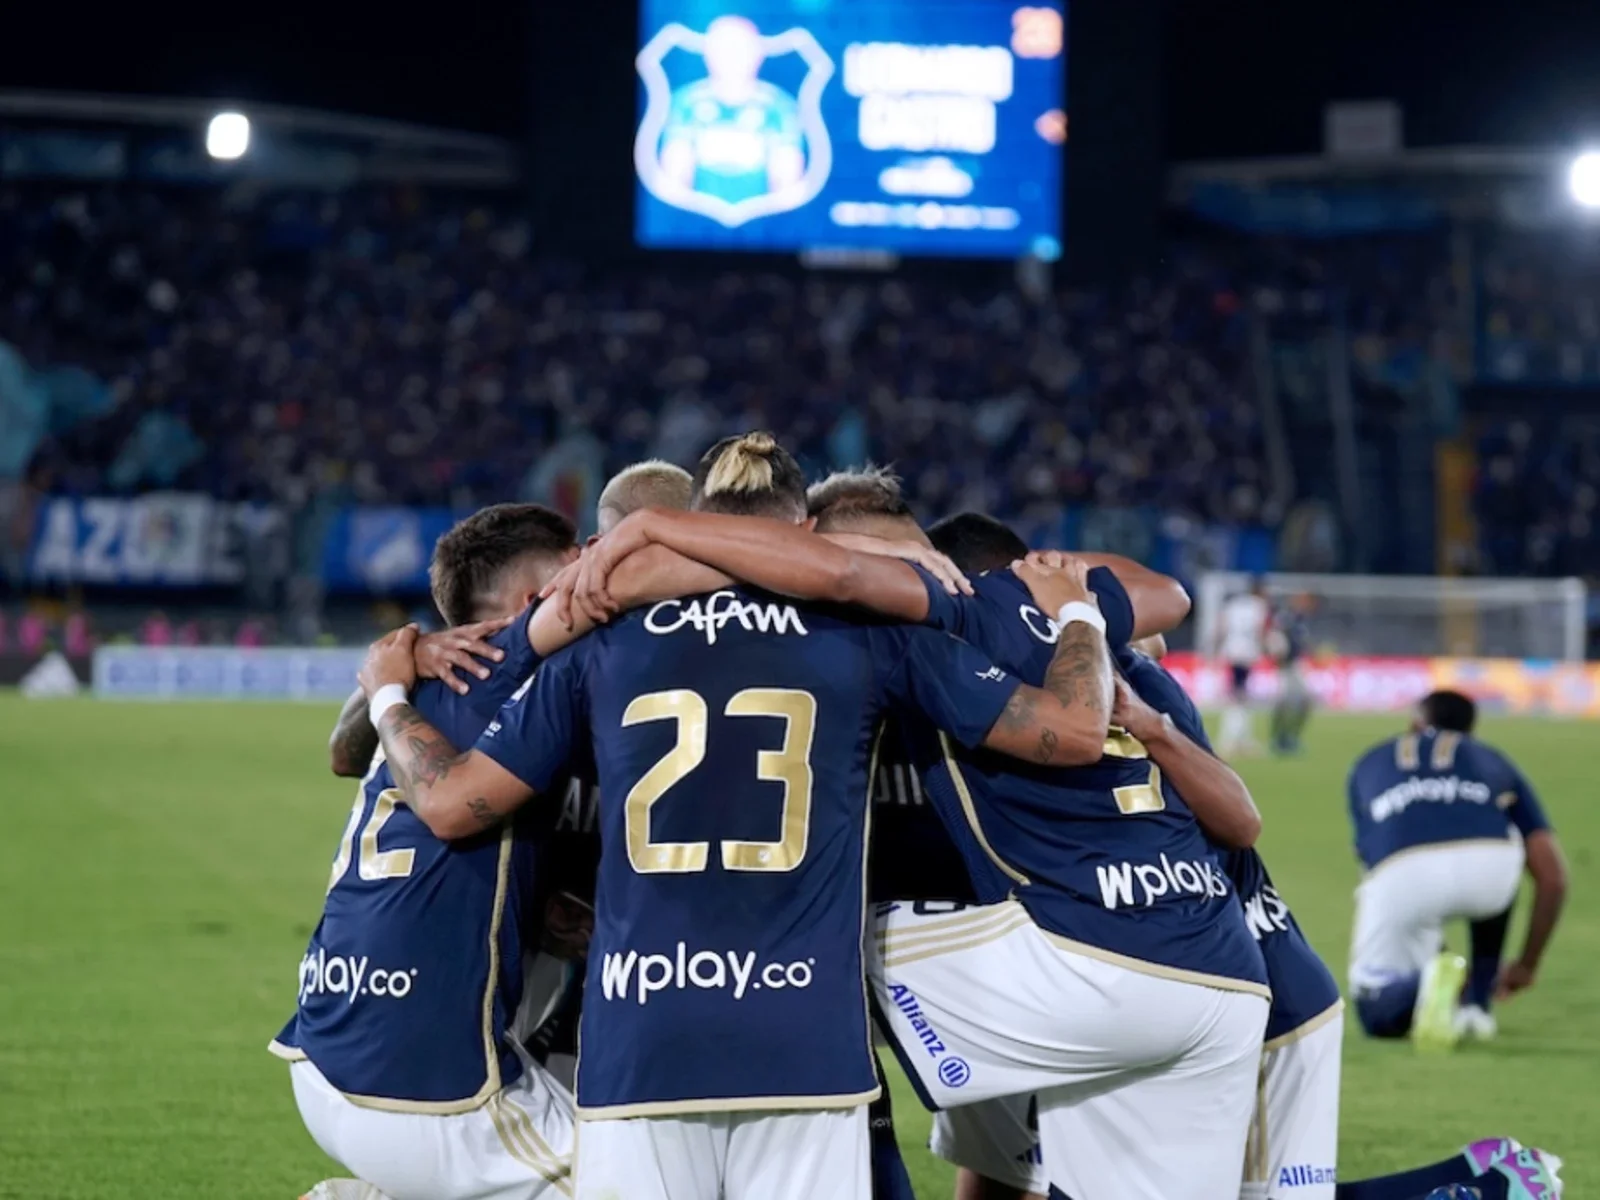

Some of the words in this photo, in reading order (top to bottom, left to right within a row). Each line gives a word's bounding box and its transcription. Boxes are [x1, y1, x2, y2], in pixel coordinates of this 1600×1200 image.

[621, 688, 817, 874] 23
[602, 941, 815, 1005] Wplay.co
[887, 984, 947, 1058] Allianz
[1278, 1164, 1337, 1189] Allian
